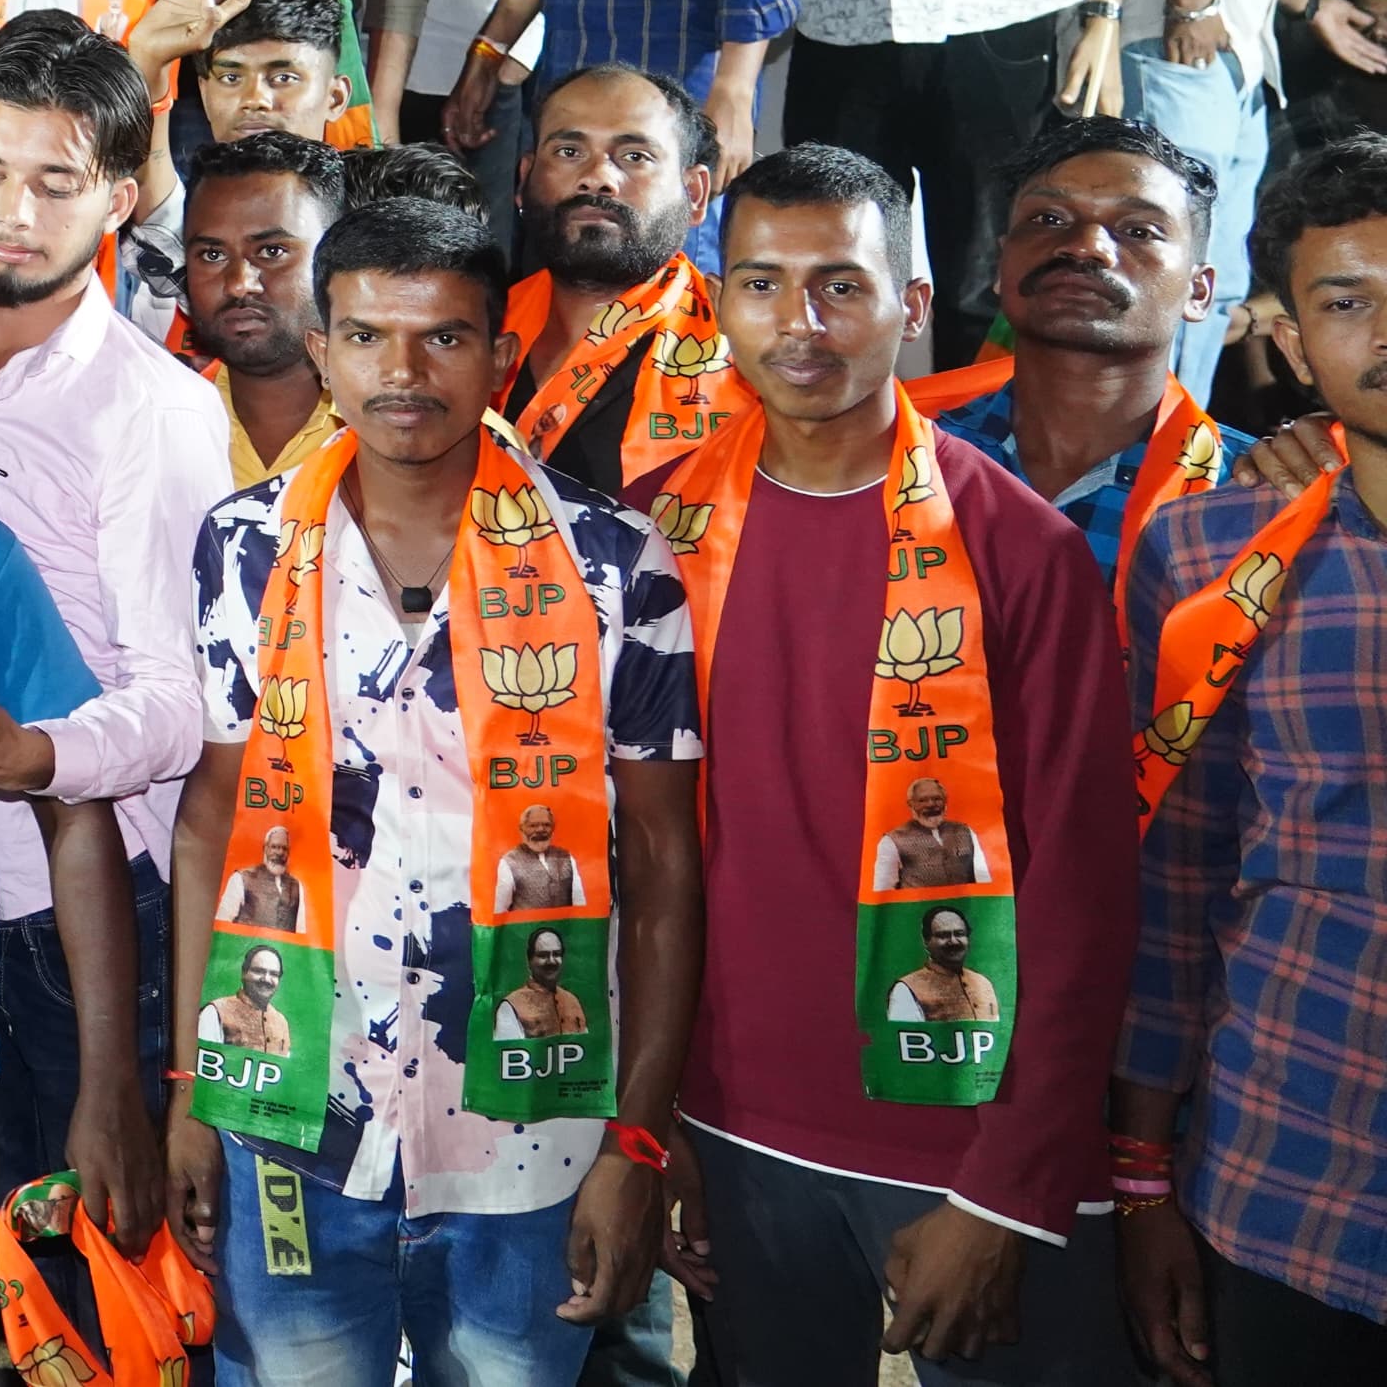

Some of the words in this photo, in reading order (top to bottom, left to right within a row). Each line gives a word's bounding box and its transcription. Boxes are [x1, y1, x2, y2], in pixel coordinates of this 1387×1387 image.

[887, 546, 948, 581] JP
[480, 583, 566, 620] BJP
[867, 724, 969, 764] BJP
[490, 755, 577, 790] BJP
[501, 1043, 585, 1081] BJP
[898, 1030, 995, 1066] BJP
[197, 1048, 284, 1093] BJP
